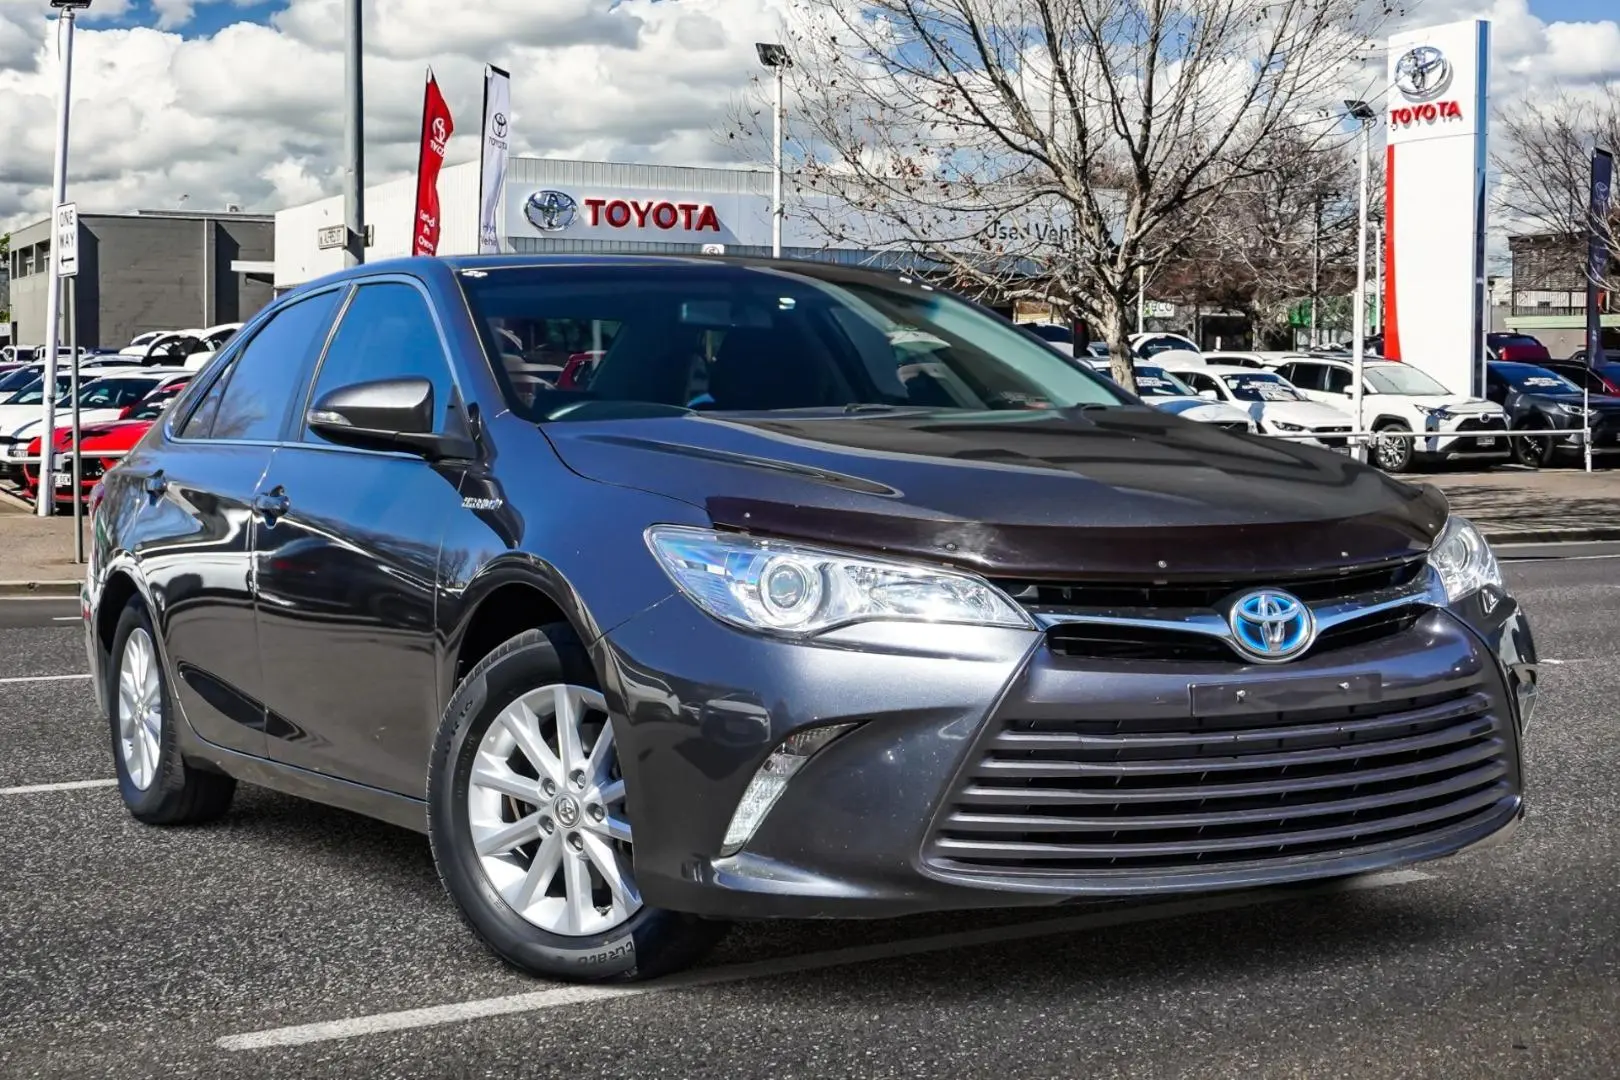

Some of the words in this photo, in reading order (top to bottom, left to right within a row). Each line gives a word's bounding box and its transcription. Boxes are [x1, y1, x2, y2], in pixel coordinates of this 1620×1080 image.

[1390, 101, 1461, 124] TOYOTA
[60, 210, 73, 228] ONE
[584, 199, 720, 231] TOYOTA
[59, 232, 75, 248] WAY
